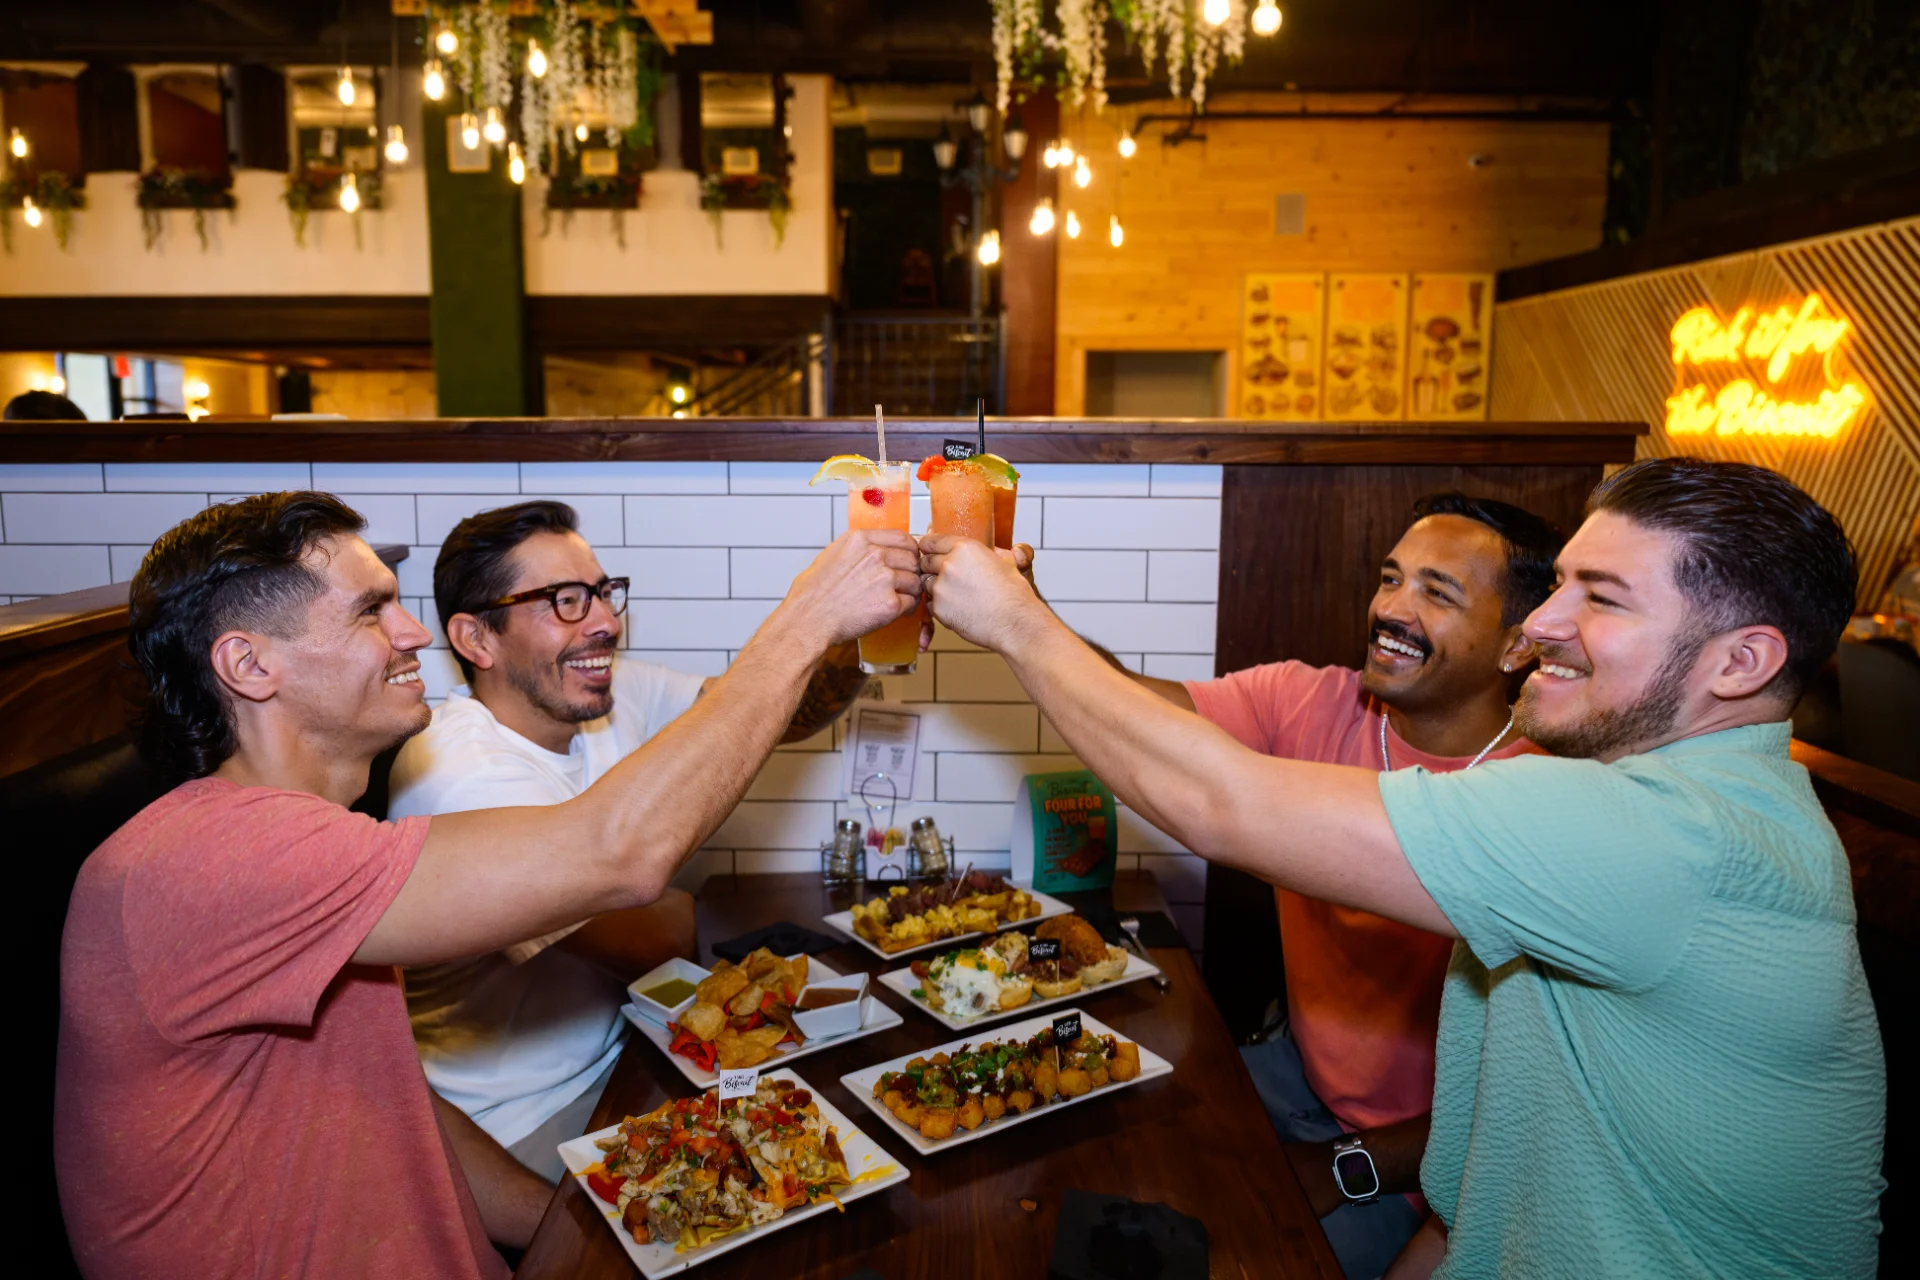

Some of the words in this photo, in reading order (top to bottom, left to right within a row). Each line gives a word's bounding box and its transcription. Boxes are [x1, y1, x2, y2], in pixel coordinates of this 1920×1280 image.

[1667, 386, 1717, 435] the
[1044, 799, 1076, 813] FOUR
[1077, 795, 1102, 809] FOR
[1060, 811, 1088, 826] YOU
